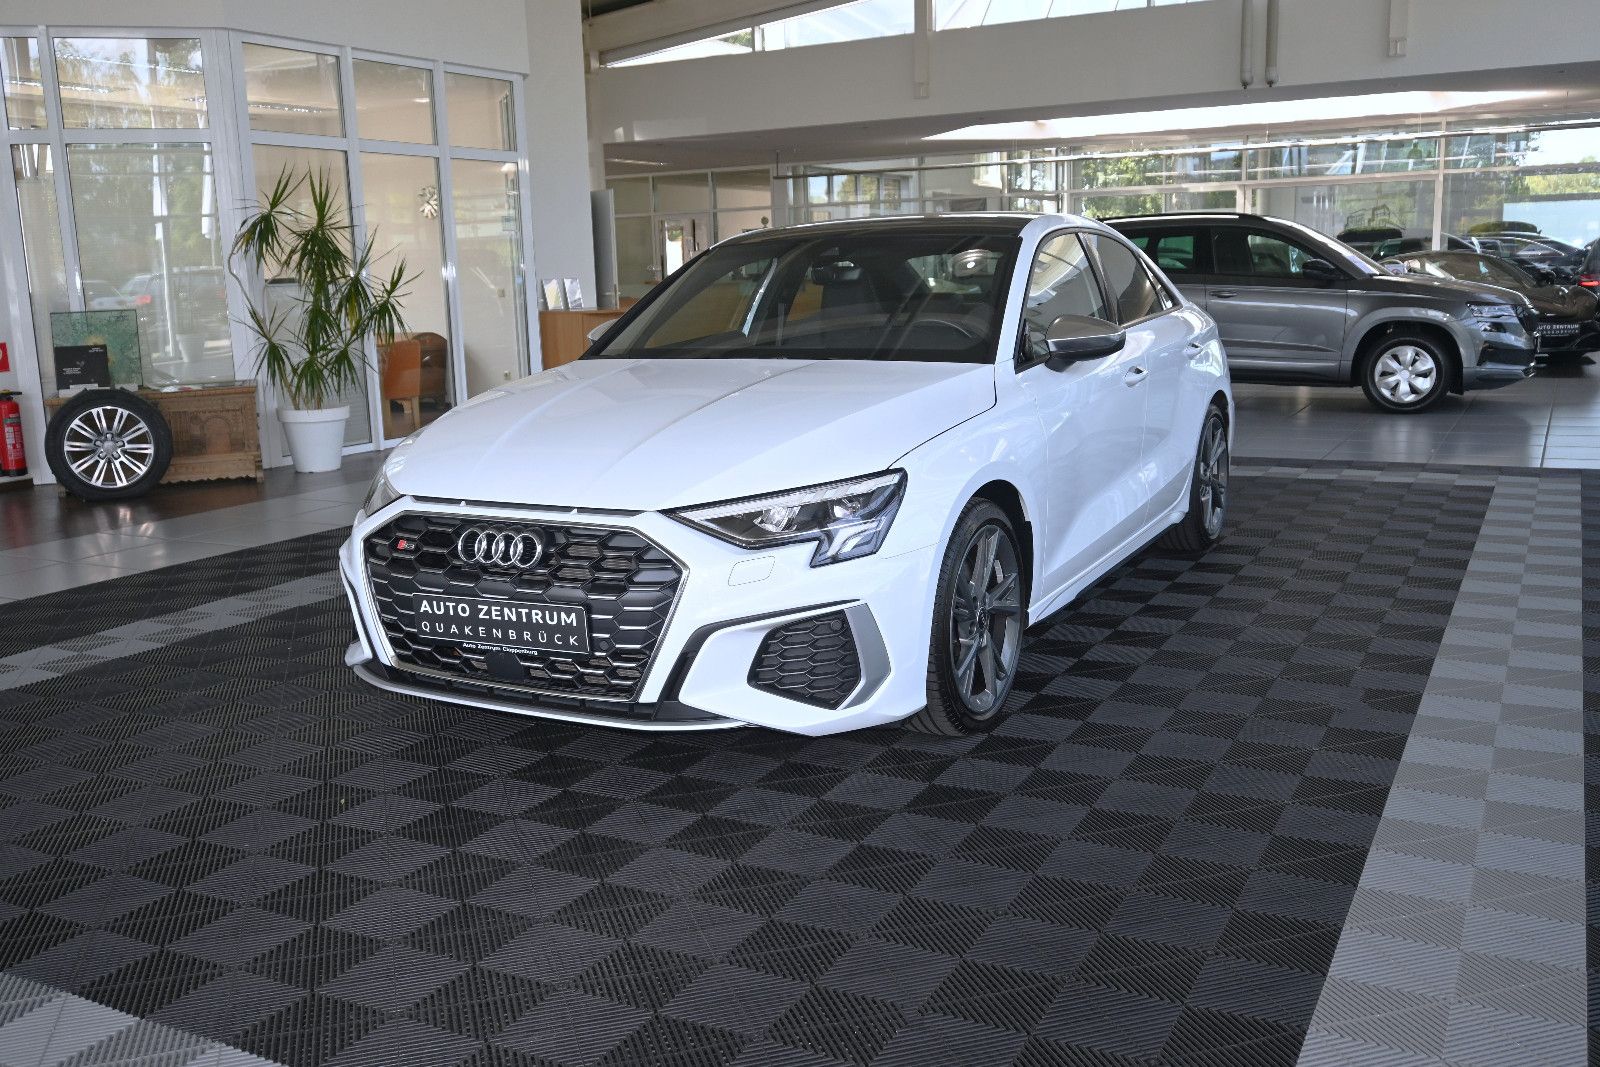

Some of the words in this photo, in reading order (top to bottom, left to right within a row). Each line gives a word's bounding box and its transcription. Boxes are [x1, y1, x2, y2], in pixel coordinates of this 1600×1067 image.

[420, 600, 470, 617] AUTO
[478, 604, 577, 626] ZENTRUM
[421, 621, 579, 646] QUAKENBRÜCK
[477, 643, 501, 651] Zentrum
